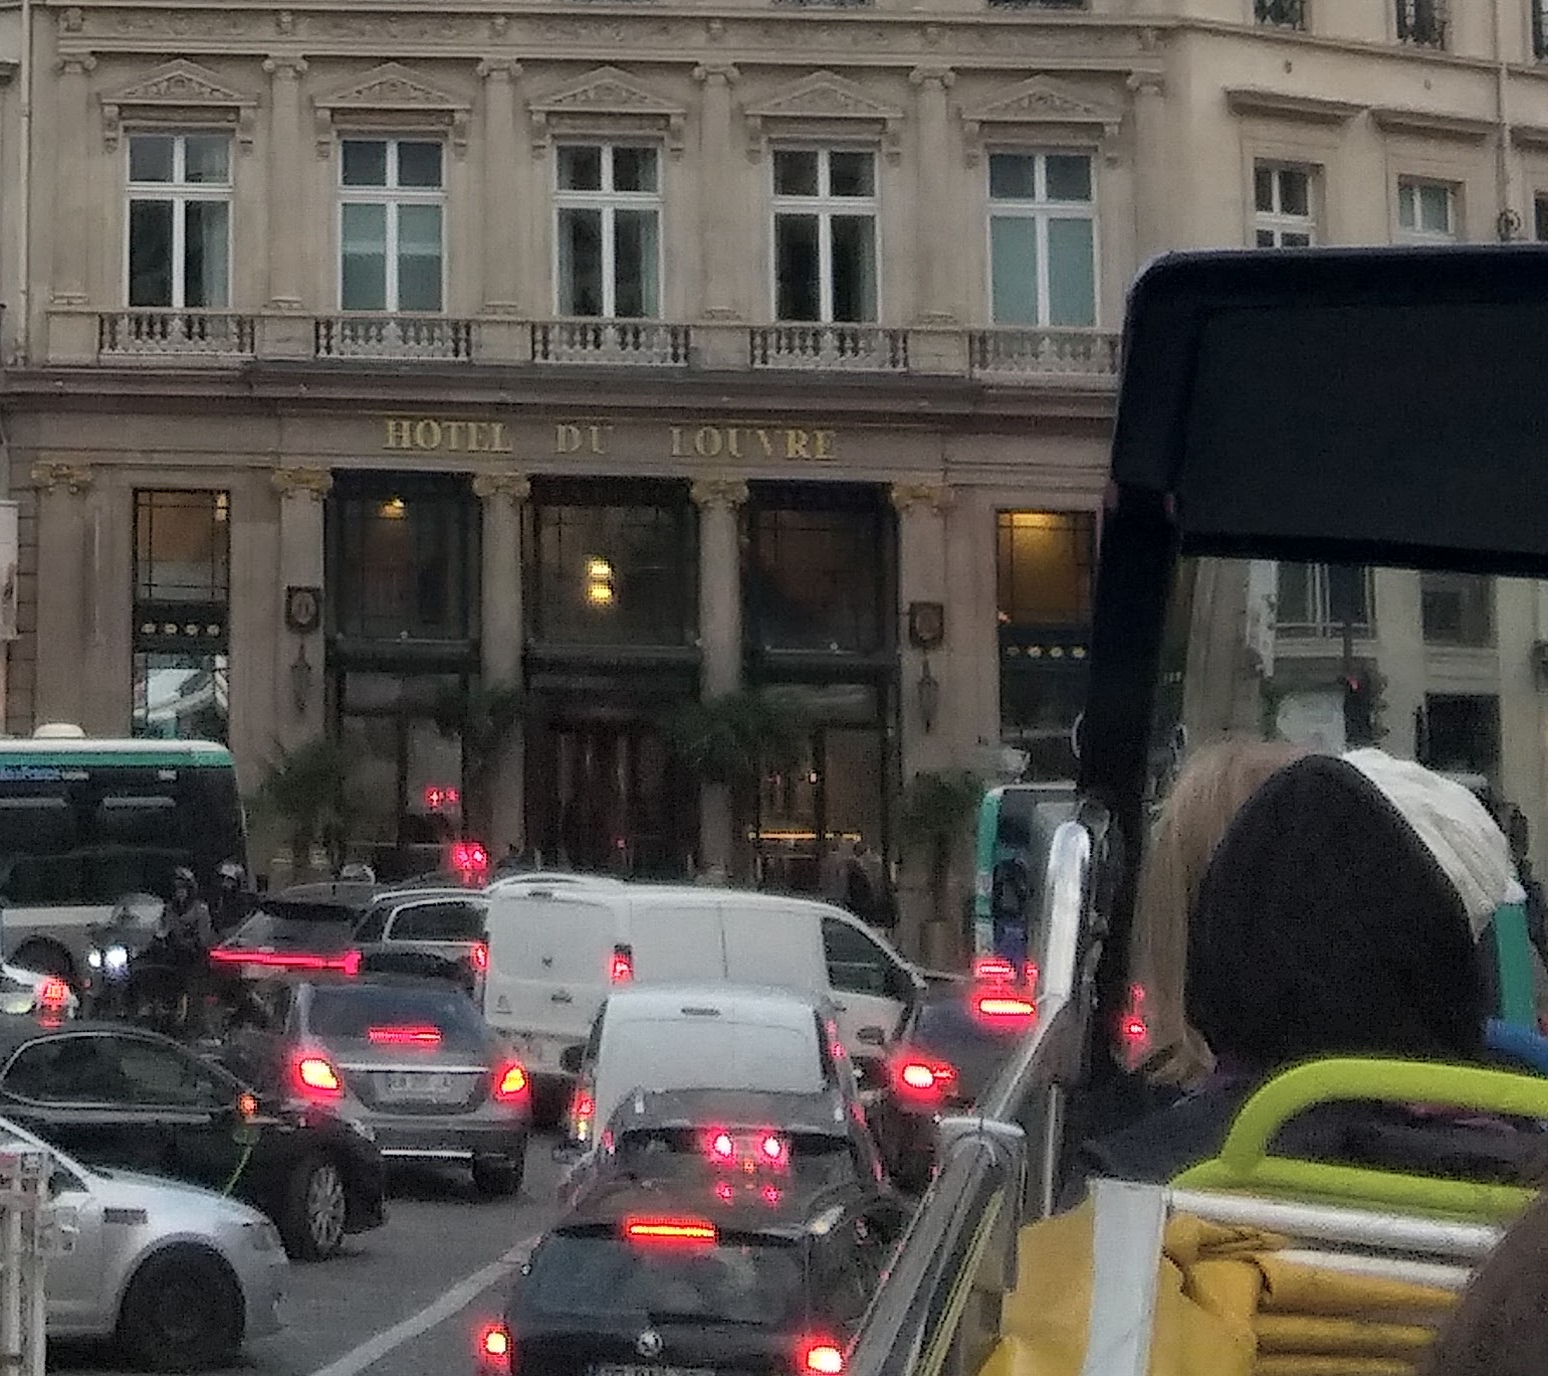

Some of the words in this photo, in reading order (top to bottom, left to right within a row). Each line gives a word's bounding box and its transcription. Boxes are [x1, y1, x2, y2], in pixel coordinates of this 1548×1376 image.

[382, 419, 513, 453] HOTEL
[554, 423, 613, 455] DU
[669, 425, 838, 459] LOUVRE
